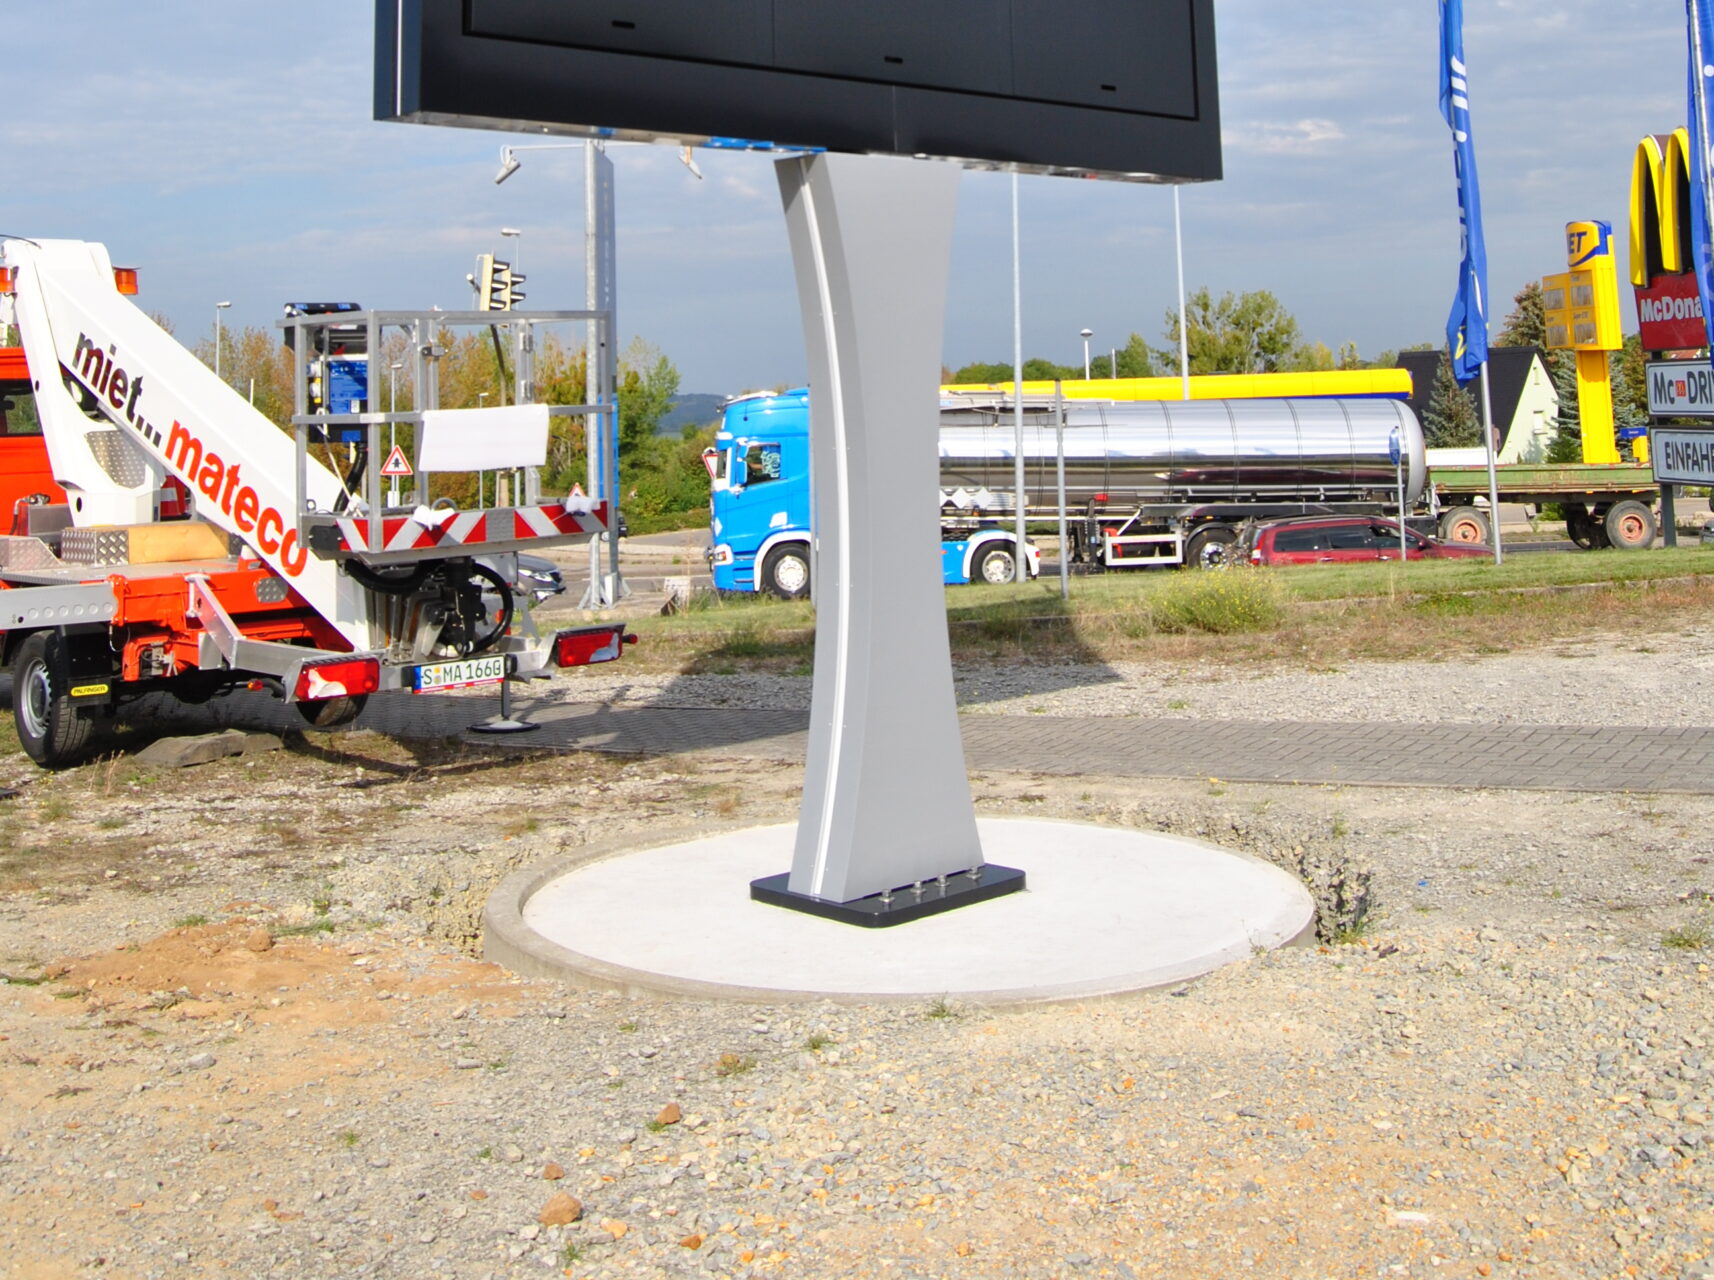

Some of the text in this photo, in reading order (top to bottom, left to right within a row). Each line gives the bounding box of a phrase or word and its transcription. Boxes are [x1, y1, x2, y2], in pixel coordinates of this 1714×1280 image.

[1568, 231, 1587, 254] ET
[1641, 295, 1703, 322] McDona
[164, 419, 308, 577] mateco
[423, 668, 433, 685] S
[443, 664, 462, 682] MA
